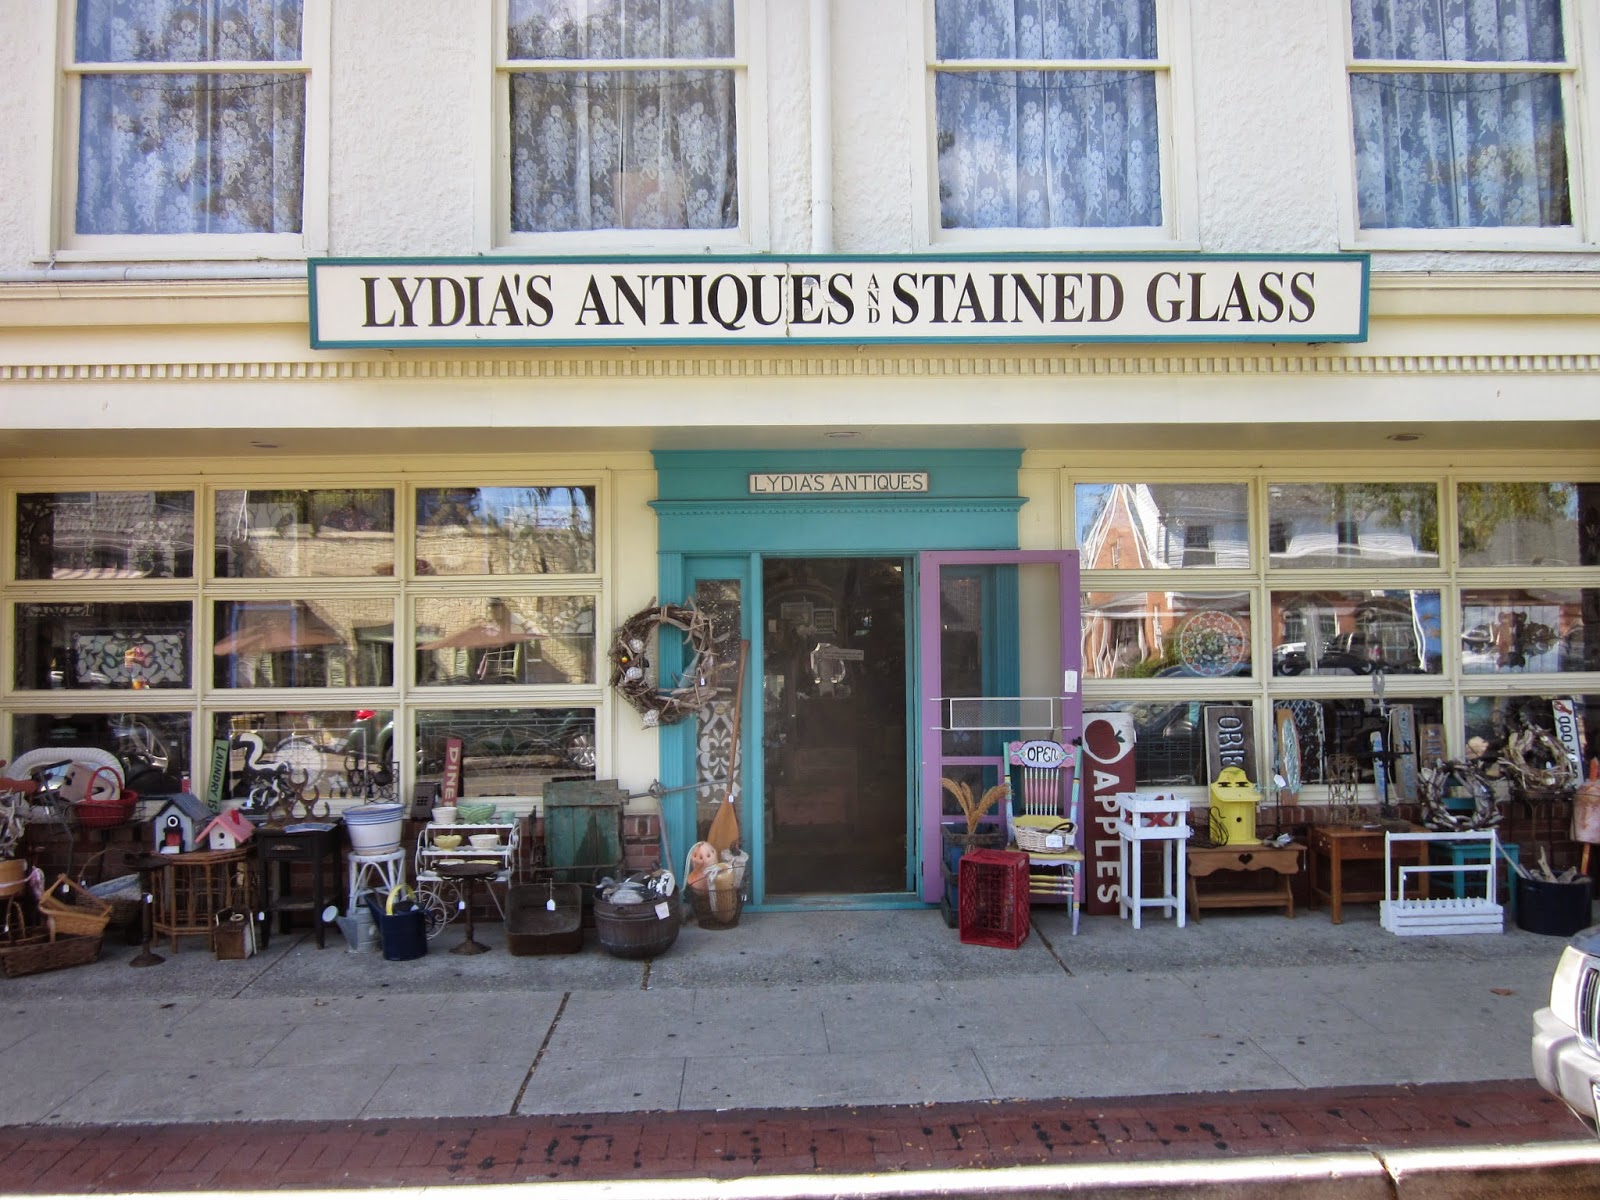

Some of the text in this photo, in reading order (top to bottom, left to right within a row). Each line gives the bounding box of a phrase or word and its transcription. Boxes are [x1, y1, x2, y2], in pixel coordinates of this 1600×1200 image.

[360, 273, 554, 328] LYDIA'S
[574, 272, 855, 331] ANTIQUES
[891, 272, 1124, 325] STAINED
[1146, 271, 1316, 323] GLASS
[754, 474, 923, 492] LYDIA'S ANTIQUES
[210, 746, 226, 796] LAUNDRY
[1093, 769, 1121, 904] APPLES
